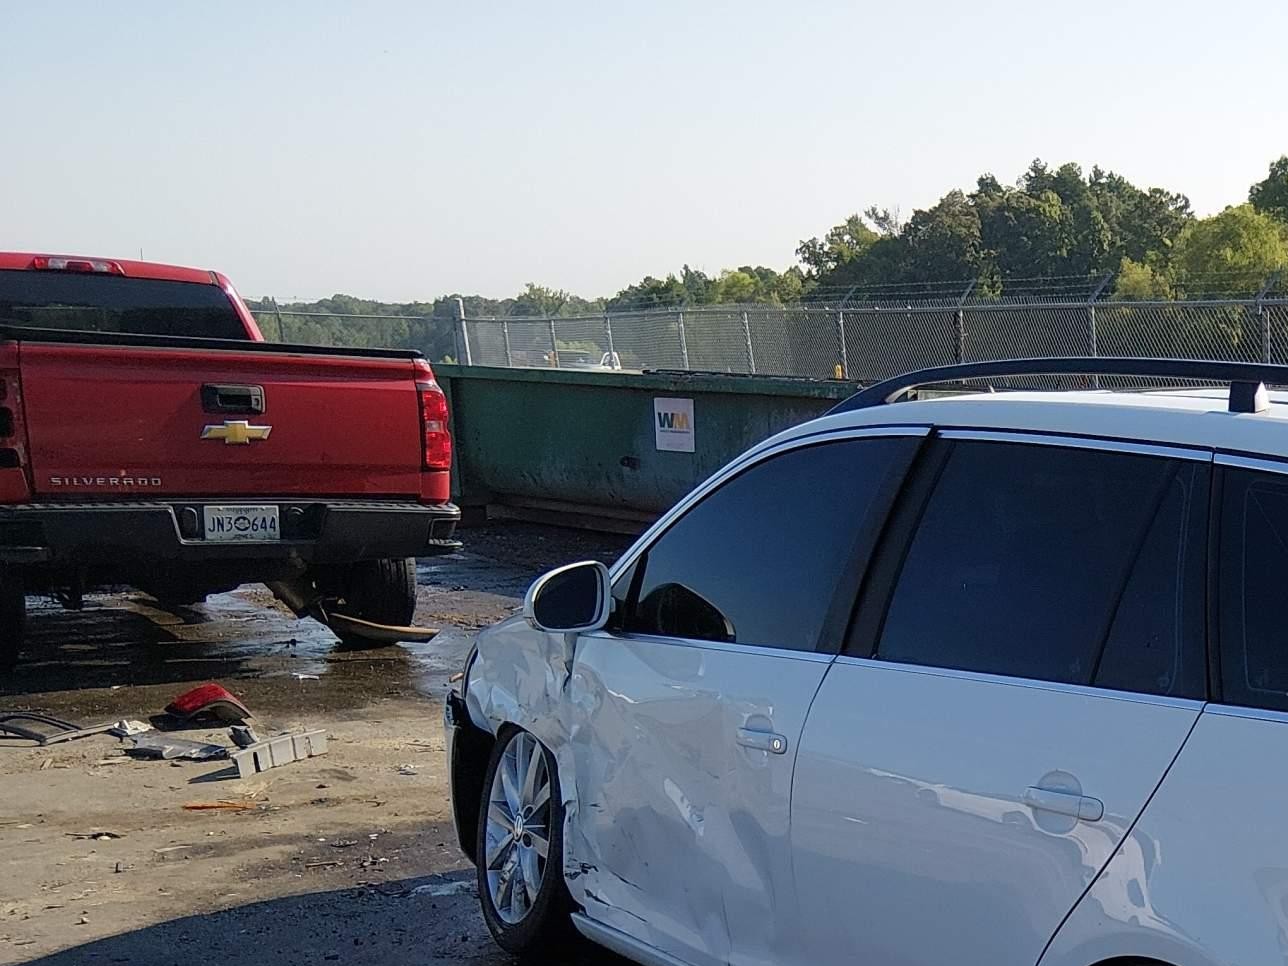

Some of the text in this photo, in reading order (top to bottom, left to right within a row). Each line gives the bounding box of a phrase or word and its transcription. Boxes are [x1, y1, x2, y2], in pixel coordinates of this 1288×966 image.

[657, 411, 690, 429] WM
[50, 477, 162, 486] SILVERADO
[207, 516, 277, 533] JN3 644
